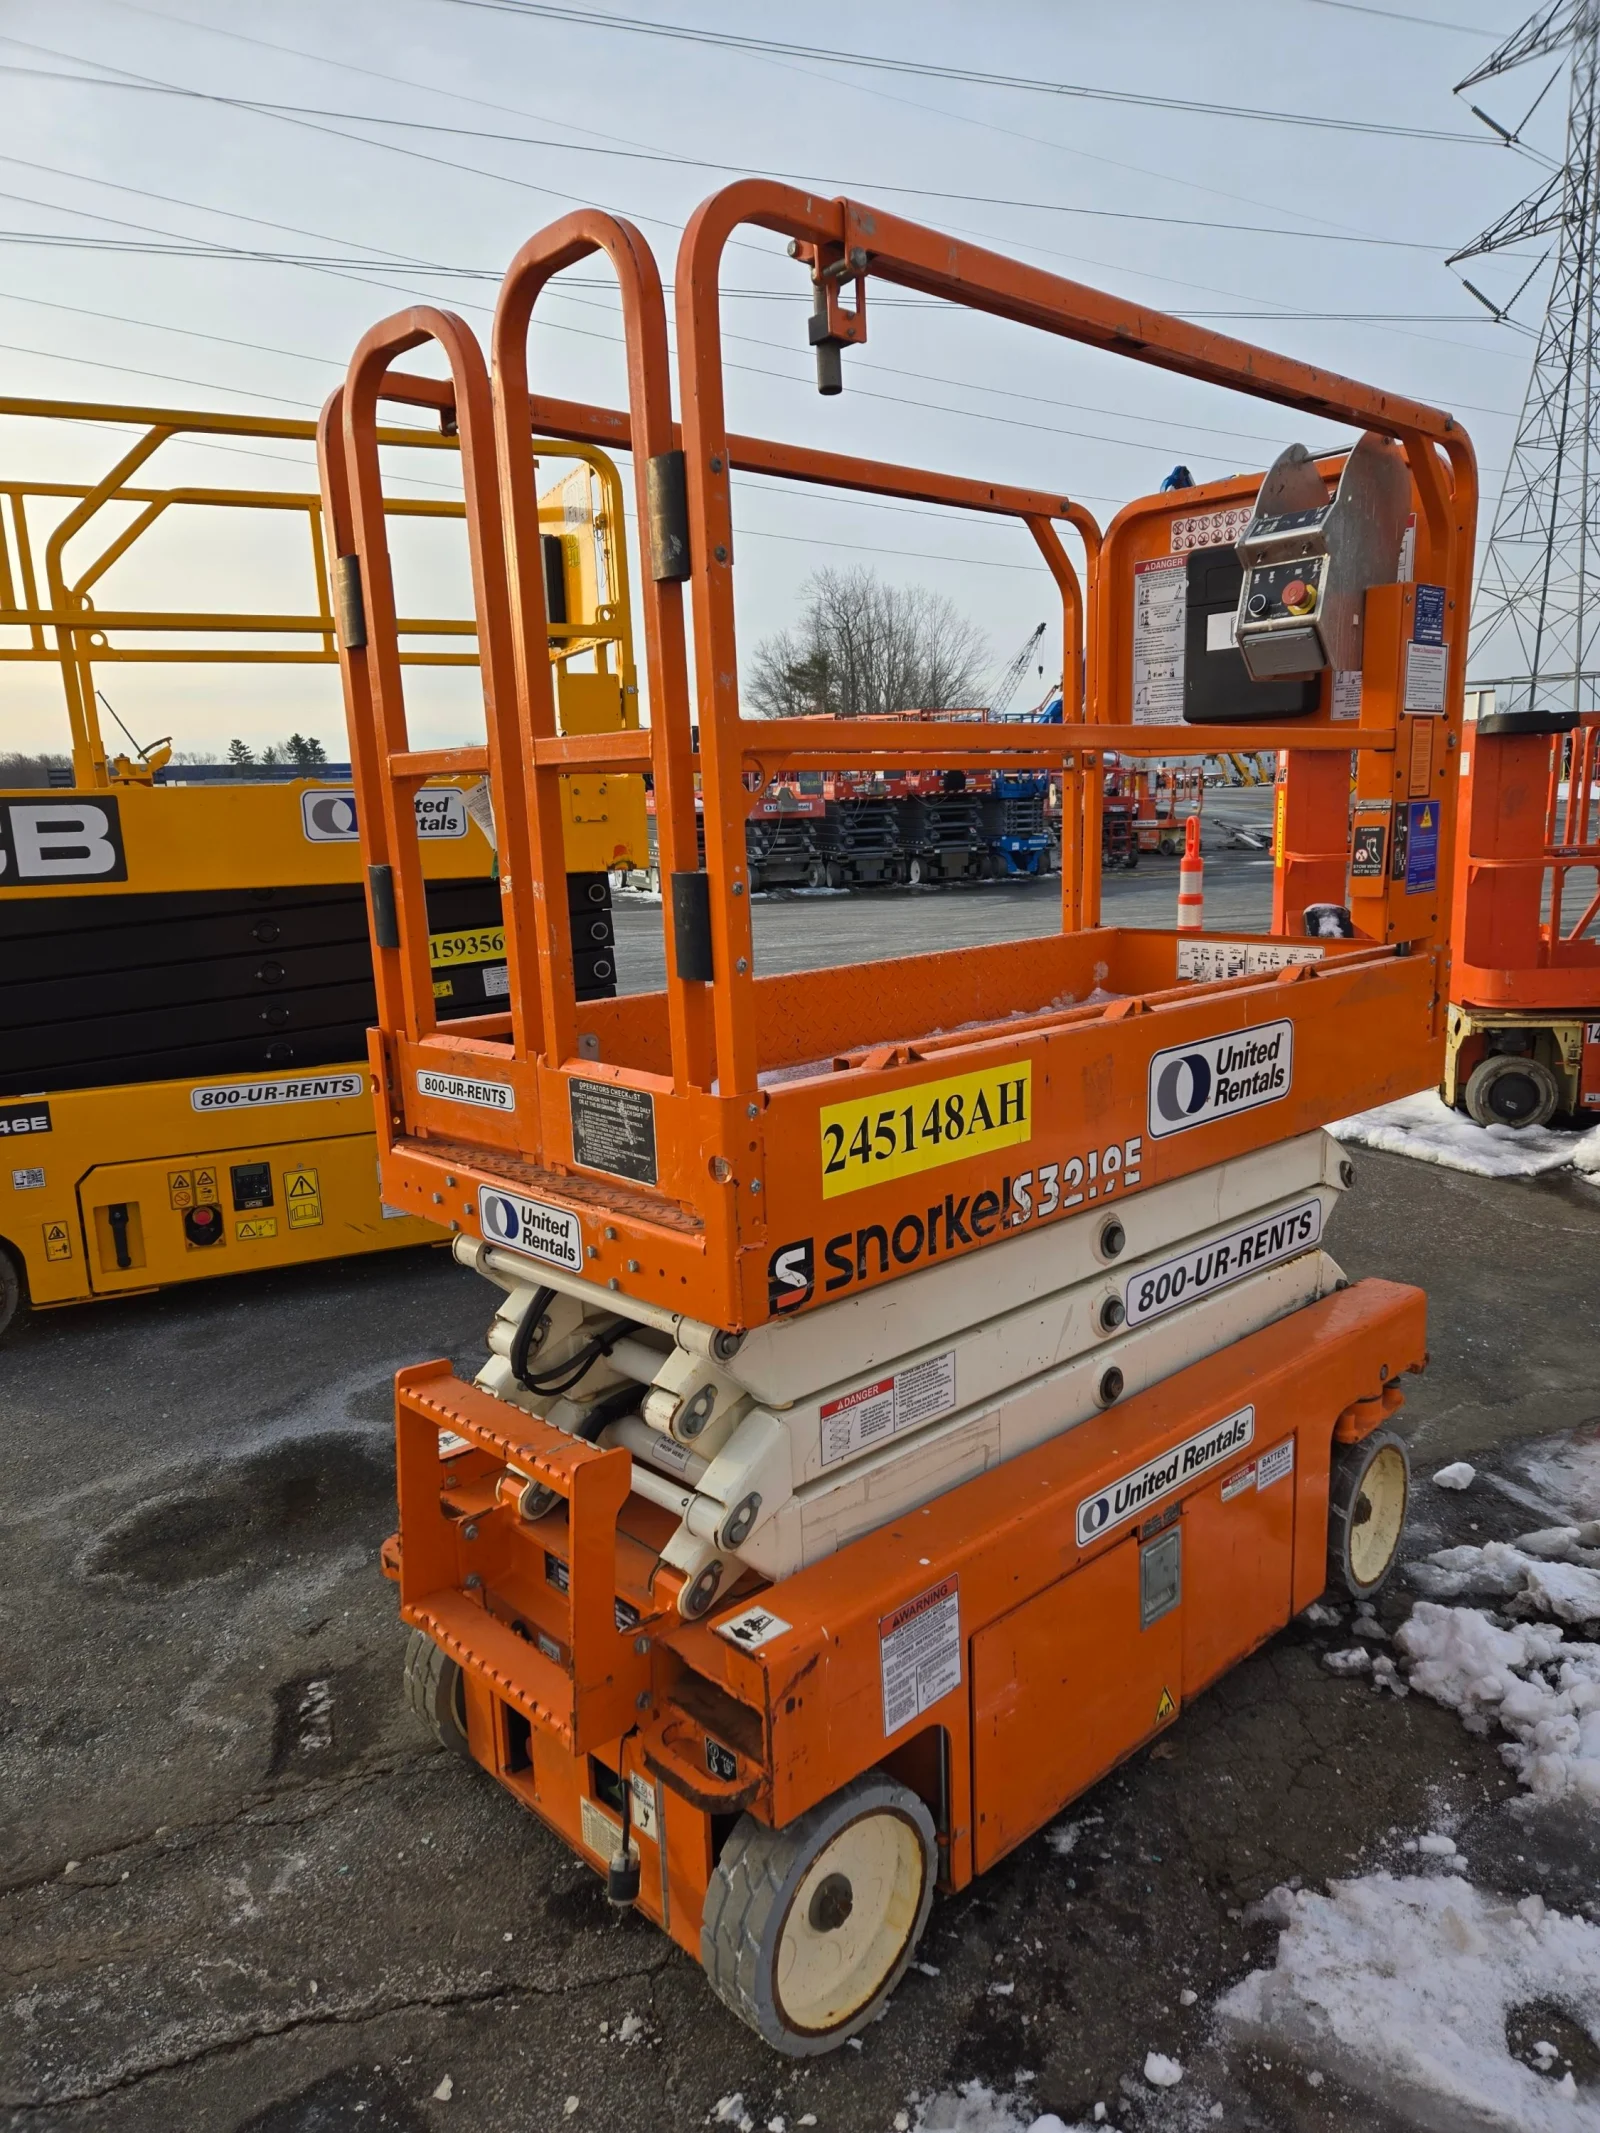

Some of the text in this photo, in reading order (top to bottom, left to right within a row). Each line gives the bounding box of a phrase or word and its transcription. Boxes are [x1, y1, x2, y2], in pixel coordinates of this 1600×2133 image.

[1150, 557, 1183, 571] DANGER
[414, 796, 450, 814] ted
[416, 814, 458, 831] tals
[431, 932, 506, 960] 159356
[1216, 1032, 1282, 1075] United
[200, 1079, 354, 1106] 800-UR-RENTS
[424, 1077, 506, 1104] 800-UR-RENTS
[579, 1081, 610, 1094] OPERATORS
[1214, 1063, 1285, 1107] Rentals
[823, 1078, 1028, 1175] 245148AH
[1012, 1136, 1142, 1225] S3219E
[521, 1205, 570, 1239] United
[826, 1176, 1011, 1292] snorkel
[522, 1226, 576, 1262] Rentals
[1138, 1210, 1312, 1312] 800-UR-RENTS
[844, 1385, 879, 1408] DANGER
[1114, 1454, 1179, 1514] United
[1183, 1420, 1246, 1473] Rentals
[1262, 1445, 1289, 1468] BATTERY
[899, 1584, 949, 1620] WARNING
